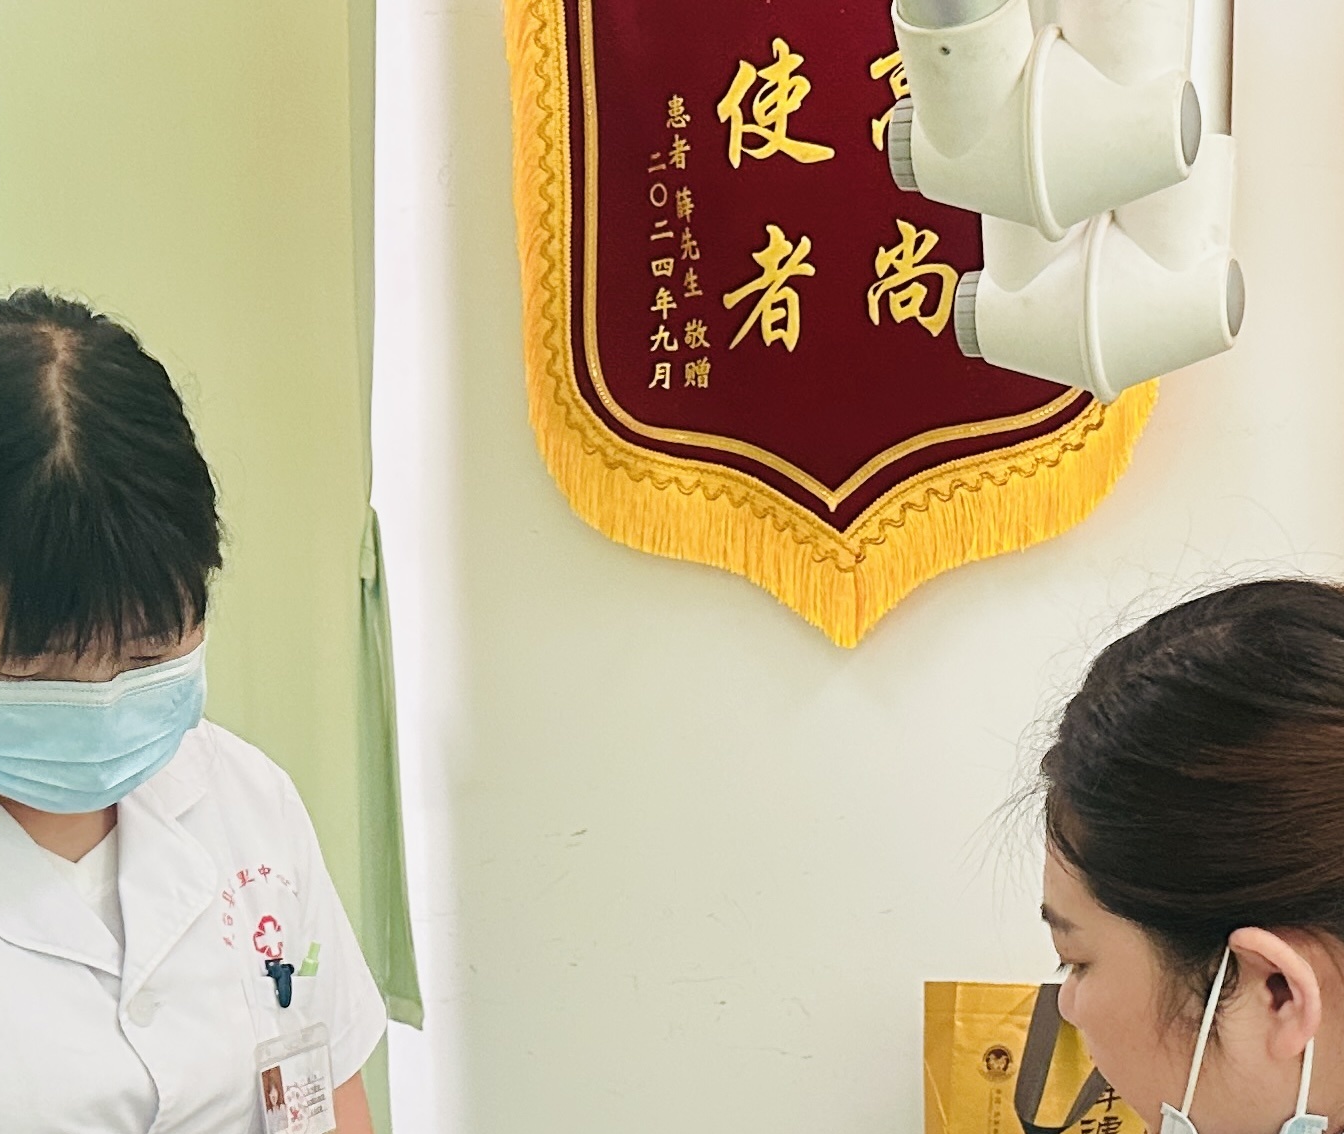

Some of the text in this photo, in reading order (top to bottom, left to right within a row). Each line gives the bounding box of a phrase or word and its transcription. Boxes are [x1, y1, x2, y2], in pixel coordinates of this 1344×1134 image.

[665, 93, 712, 389] 患者 薛先生 敬赠
[716, 37, 836, 353] 使者
